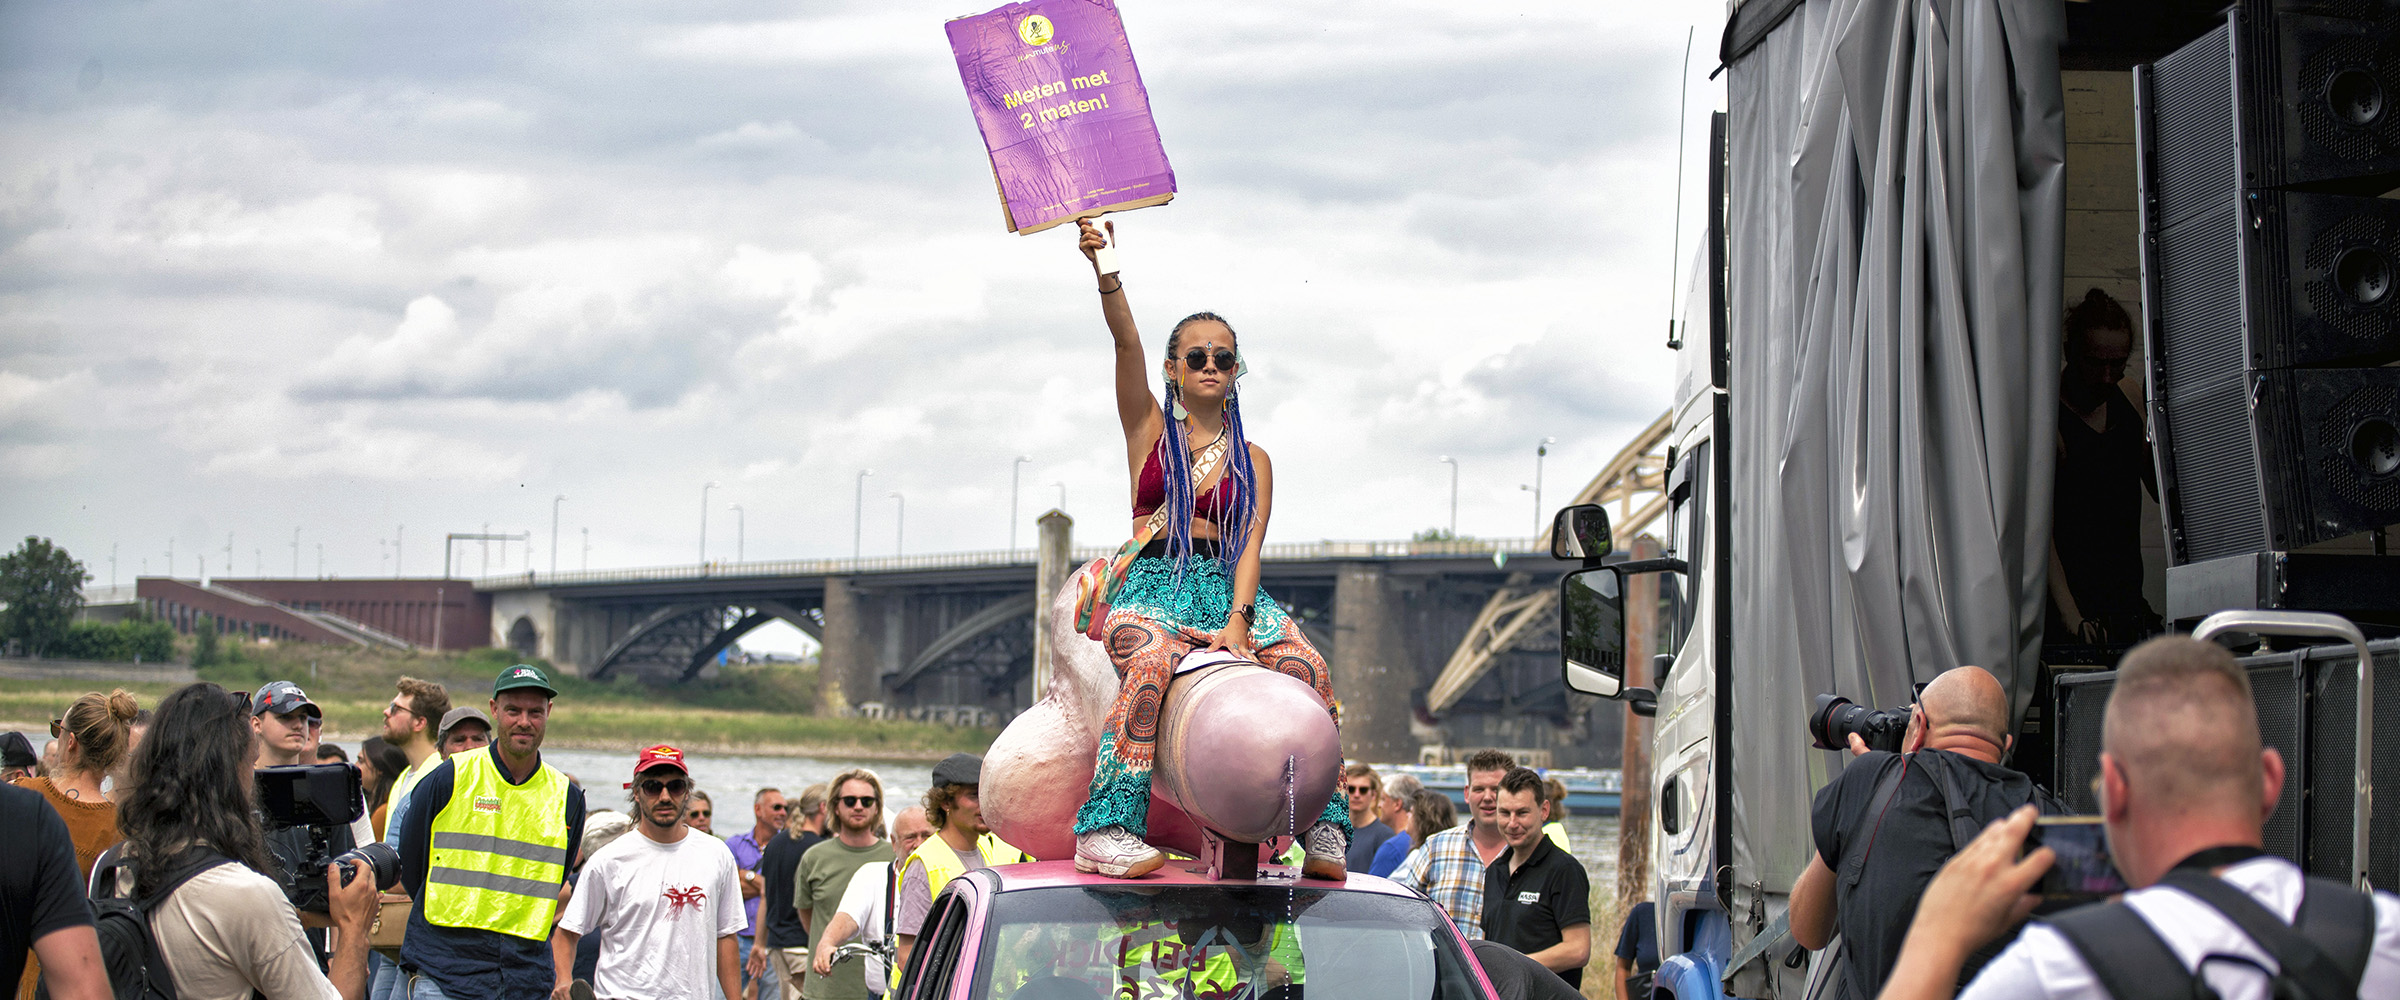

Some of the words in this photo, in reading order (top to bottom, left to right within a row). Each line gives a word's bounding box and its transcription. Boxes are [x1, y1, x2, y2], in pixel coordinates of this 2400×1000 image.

[1003, 80, 1067, 110] Meten
[1071, 70, 1110, 90] met
[1020, 112, 1035, 129] 2
[1039, 93, 1109, 123] maten!
